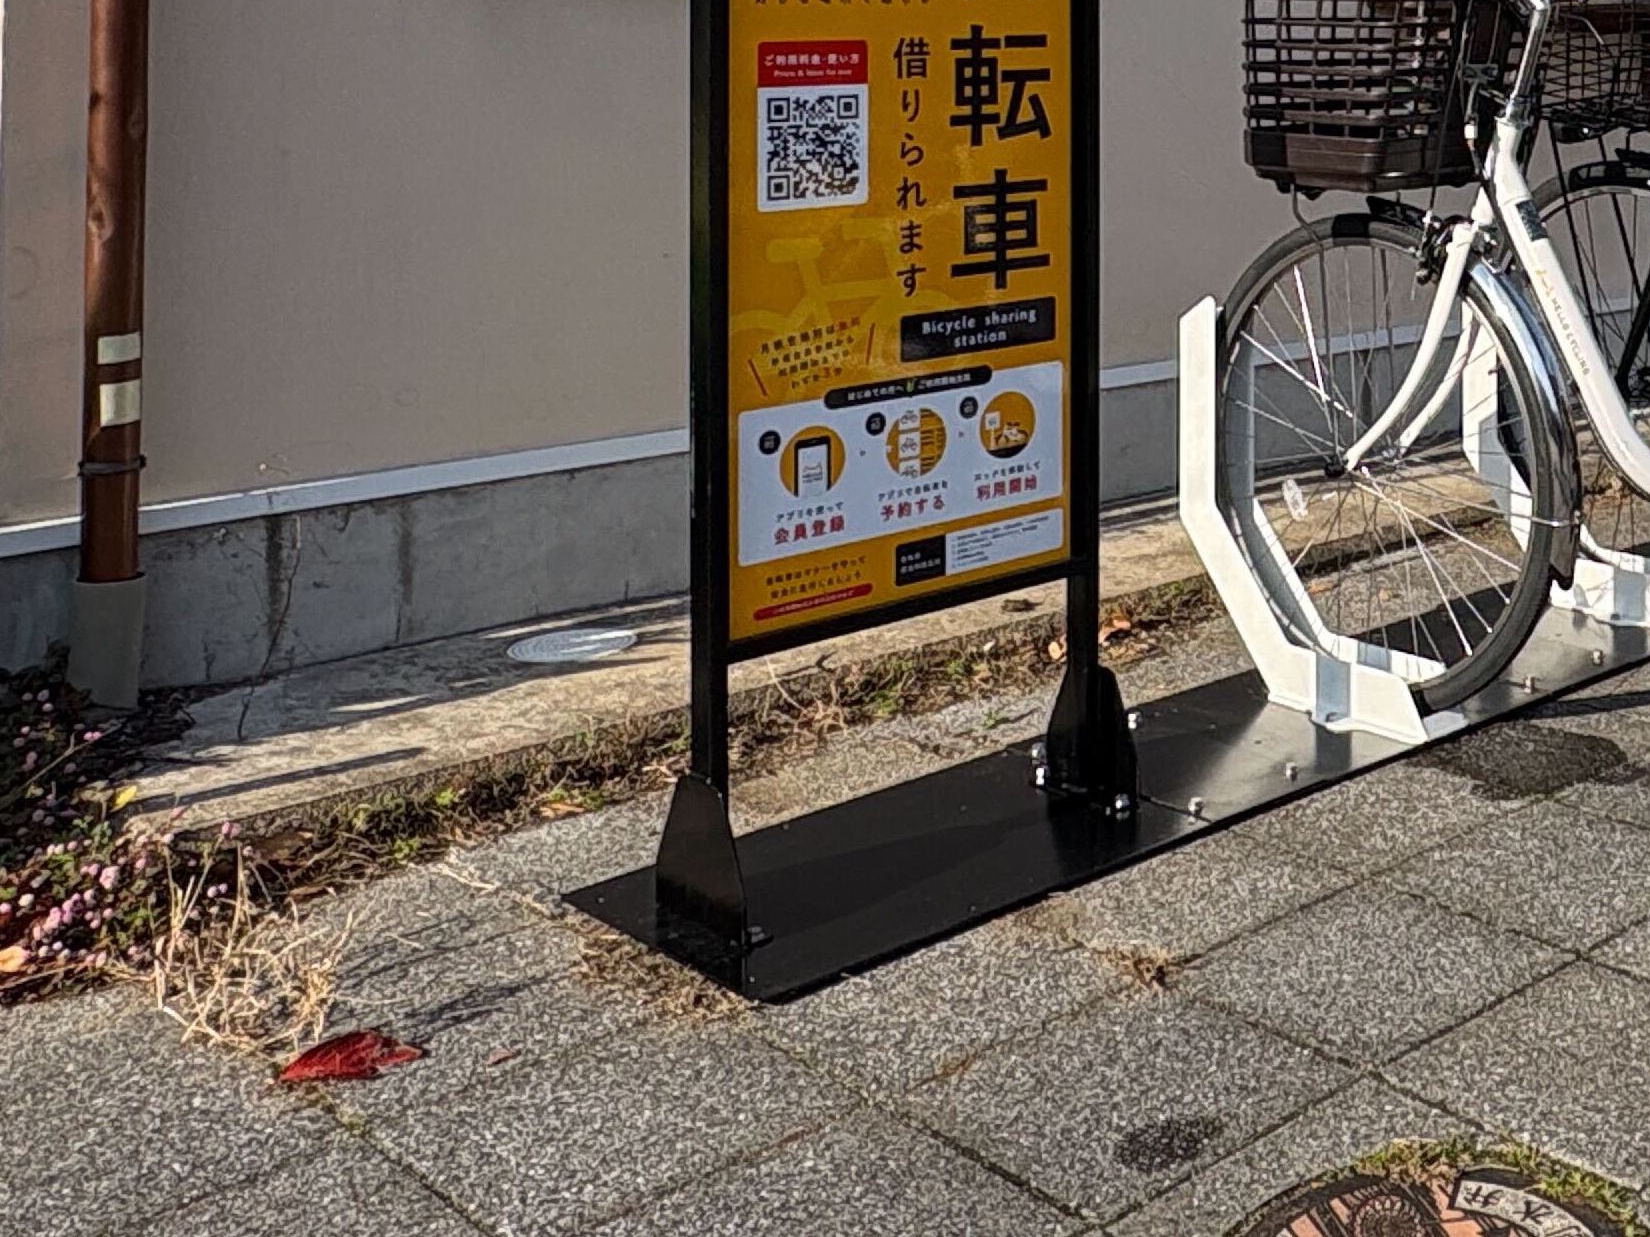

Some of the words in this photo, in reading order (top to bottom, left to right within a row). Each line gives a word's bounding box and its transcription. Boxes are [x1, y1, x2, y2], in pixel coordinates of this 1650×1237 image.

[893, 36, 931, 297] 借りられます
[921, 315, 977, 335] Bicycle
[984, 308, 1037, 329] sharing
[953, 329, 1007, 349] station
[880, 494, 946, 521] 予約する
[774, 514, 845, 544] 会員登録
